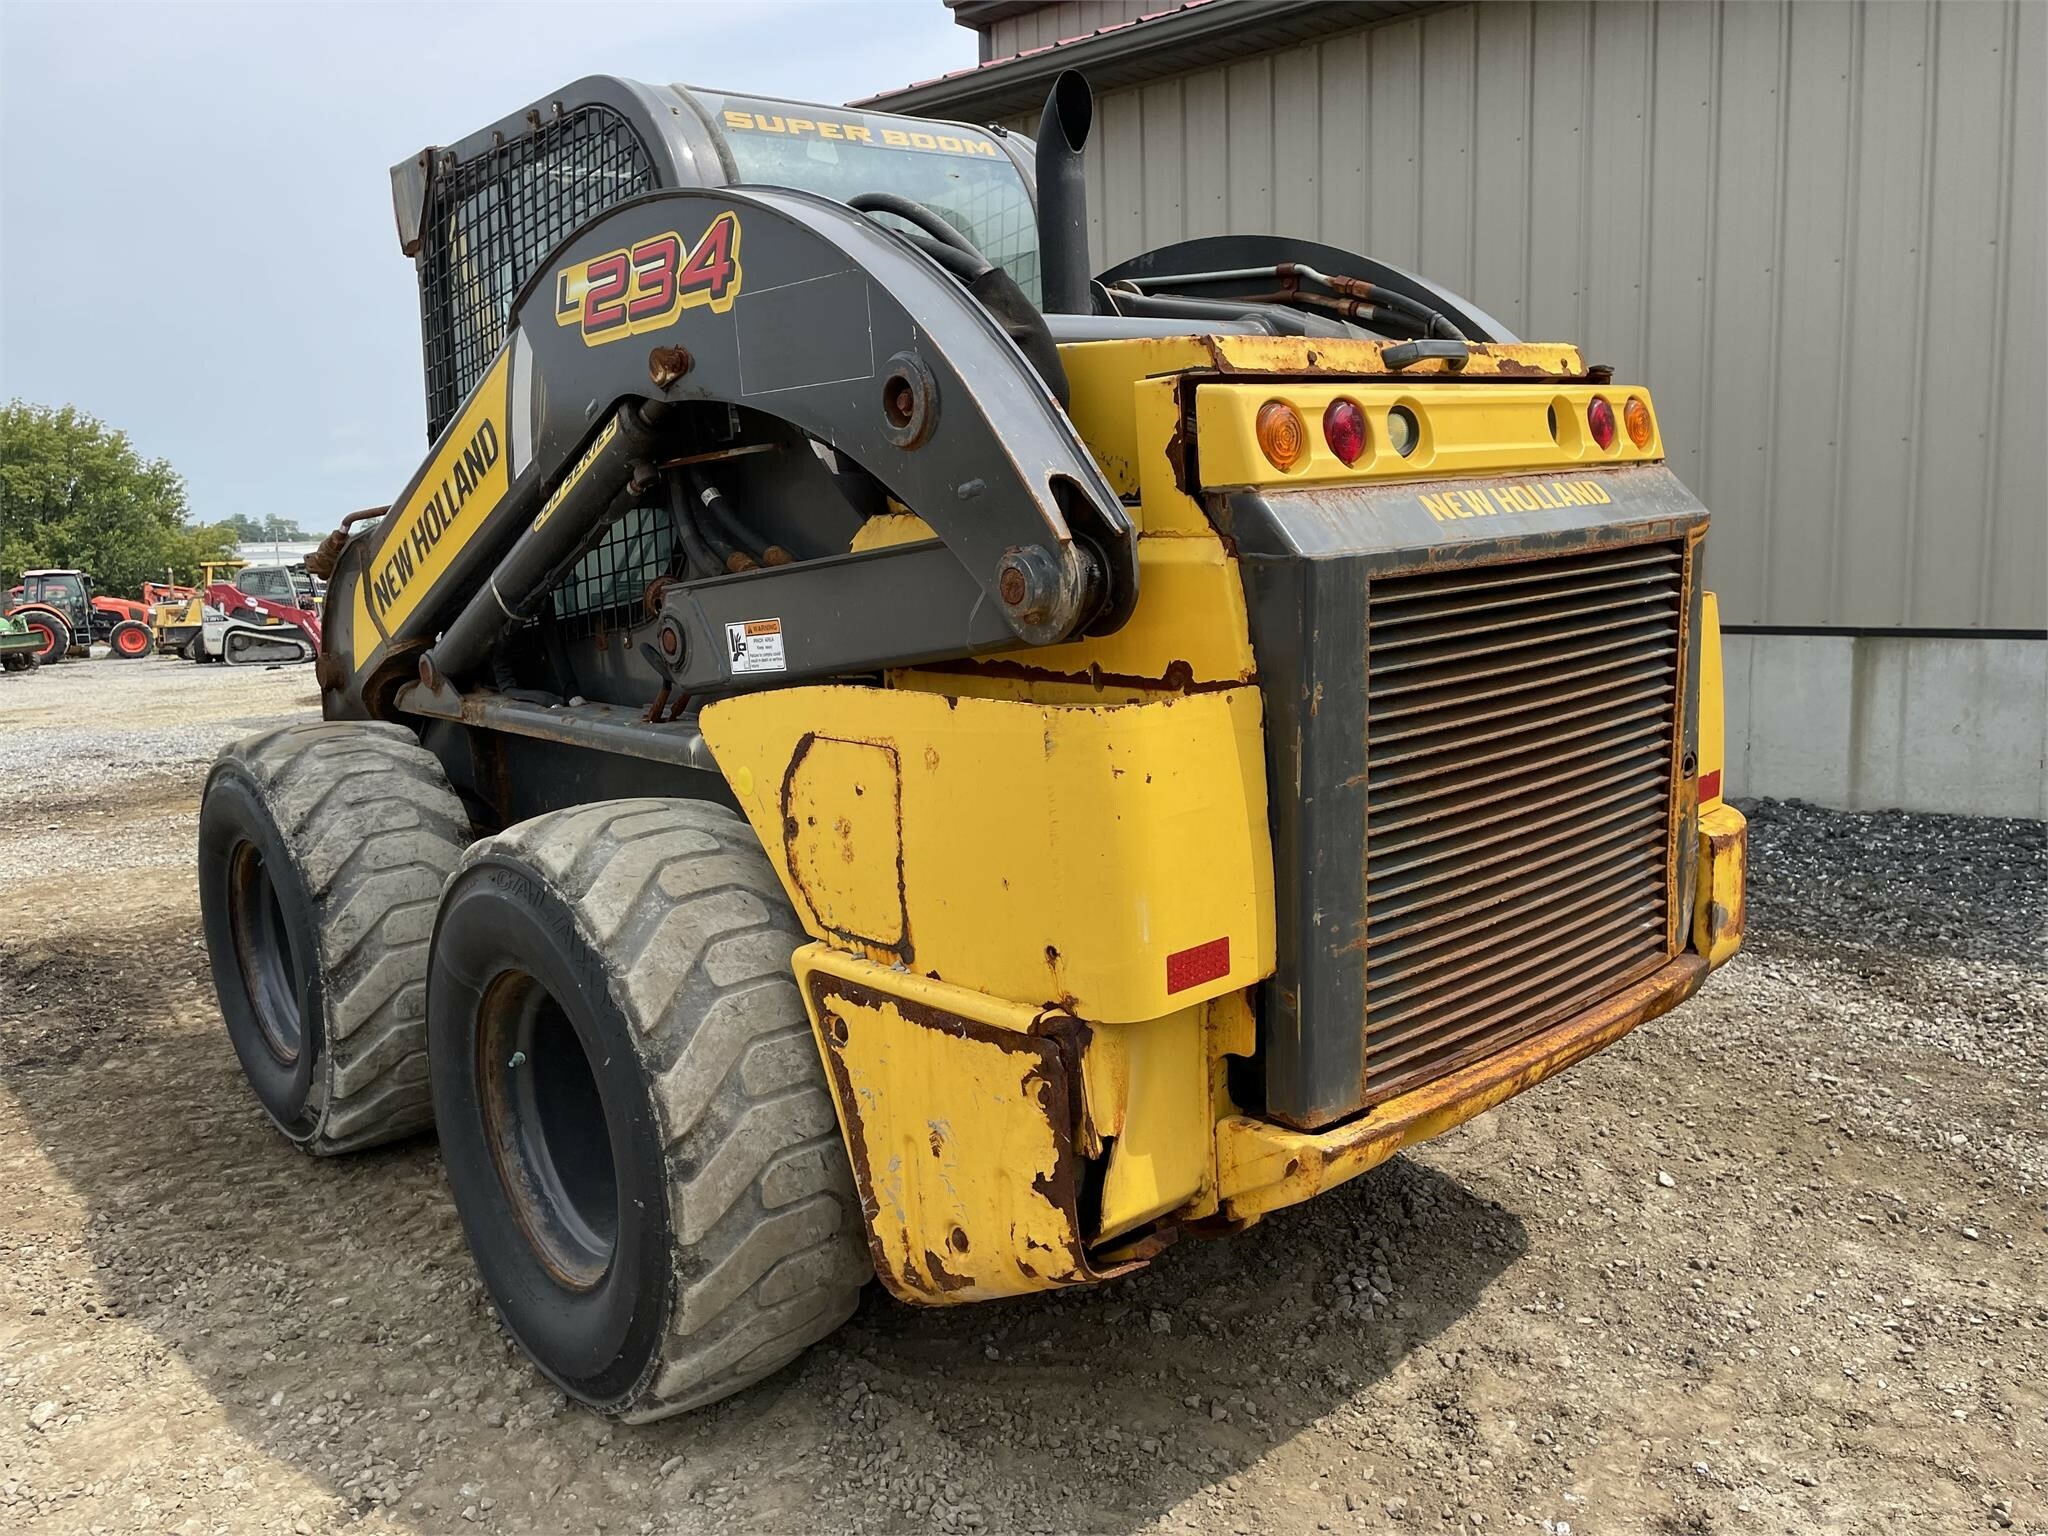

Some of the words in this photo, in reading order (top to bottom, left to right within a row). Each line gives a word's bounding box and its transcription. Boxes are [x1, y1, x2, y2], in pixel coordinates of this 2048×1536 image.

[723, 110, 873, 143] SUPER
[880, 128, 997, 156] BOOM
[556, 212, 741, 345] L234
[562, 419, 617, 491] SERIES
[373, 539, 414, 617] NEW
[410, 417, 498, 565] HOLLAND
[1419, 488, 1498, 521] NEW
[1488, 480, 1612, 513] HOLLAND
[753, 623, 778, 633] WARNING
